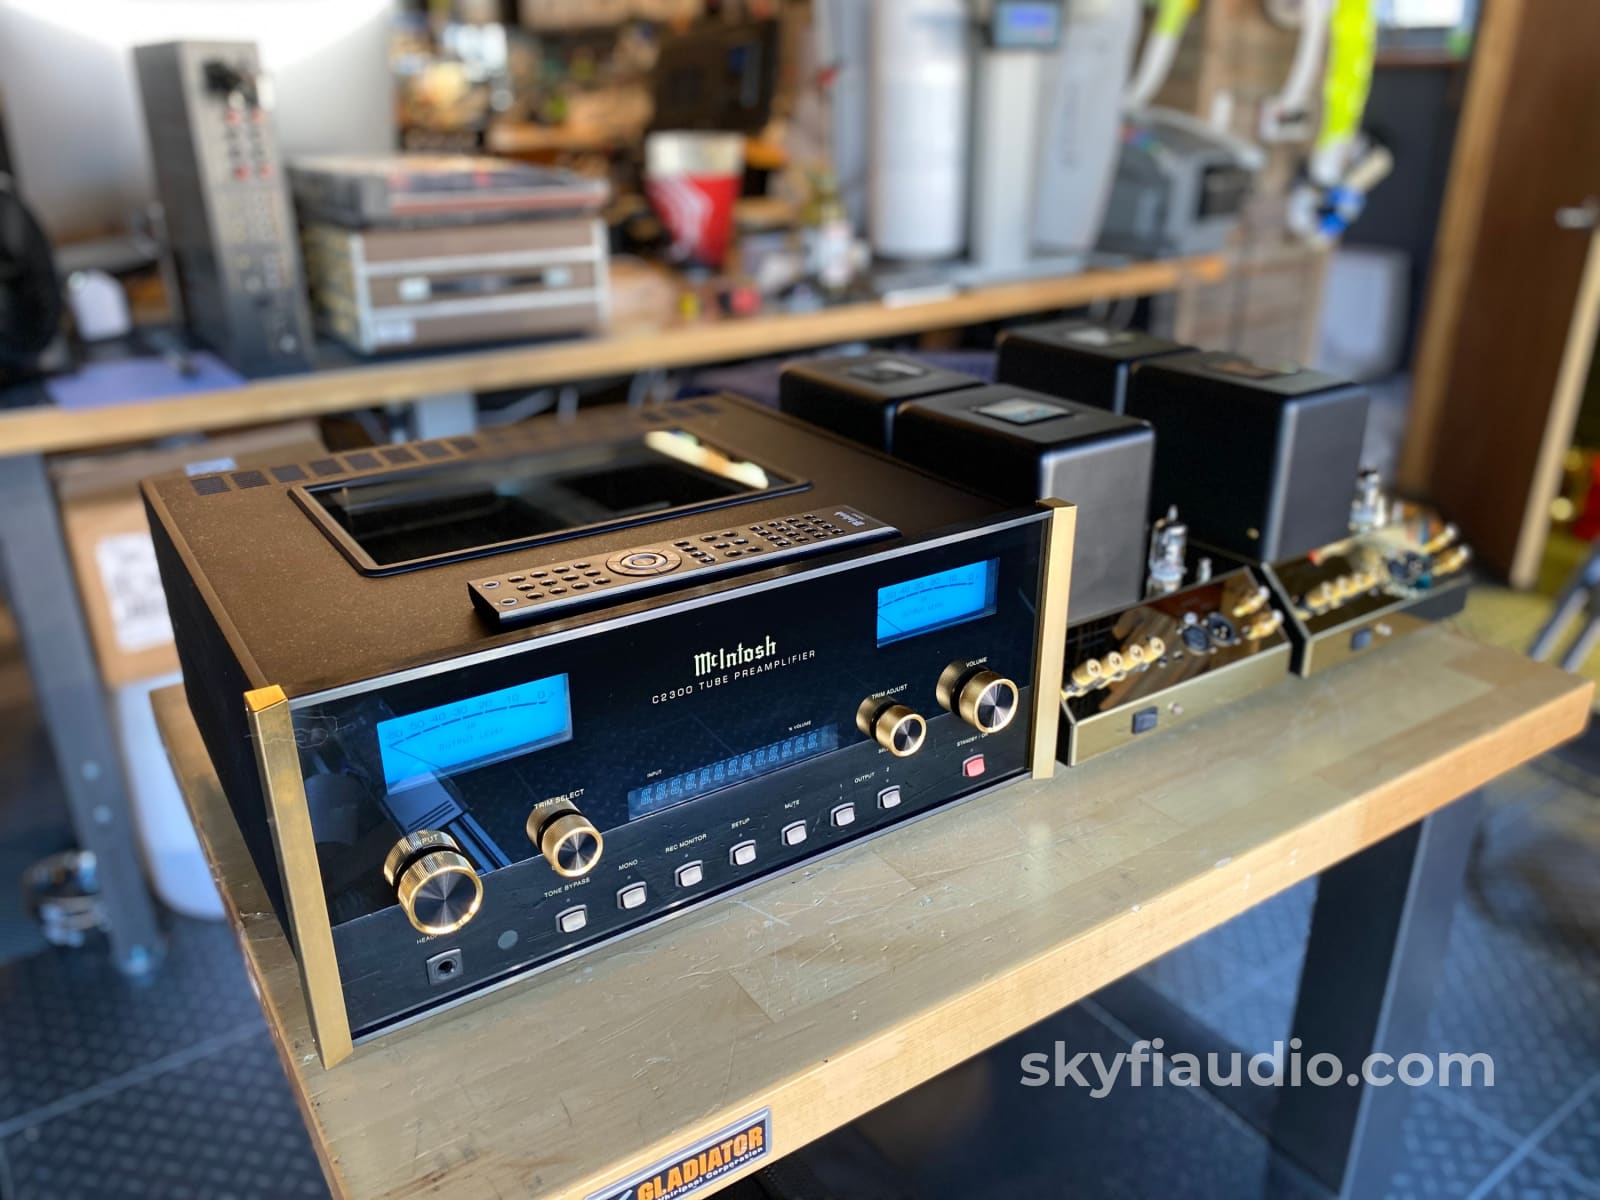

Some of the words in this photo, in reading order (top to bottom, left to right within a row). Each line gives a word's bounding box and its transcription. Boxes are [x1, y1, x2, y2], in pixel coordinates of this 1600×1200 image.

[694, 635, 777, 677] McIntosh
[966, 656, 988, 668] VOLUME
[652, 685, 693, 704] C2300
[699, 675, 729, 690] TUBE
[734, 650, 816, 680] PREAMPLIFIER
[871, 691, 886, 700] TRIM
[886, 684, 908, 695] ADJUST
[647, 769, 663, 778] INPUT
[854, 772, 875, 783] OUTPUT
[533, 798, 554, 810] TRIM
[555, 788, 585, 803] SELECT
[784, 799, 800, 809] MUTE
[731, 817, 750, 829] SETUP
[665, 843, 678, 854] REC
[679, 833, 707, 848] MONITOR
[618, 859, 638, 871] MONO
[543, 887, 562, 898] TONE
[564, 877, 590, 891] BYPASS
[637, 1126, 763, 1200] GLADIATOR
[706, 1147, 763, 1180] Corporation
